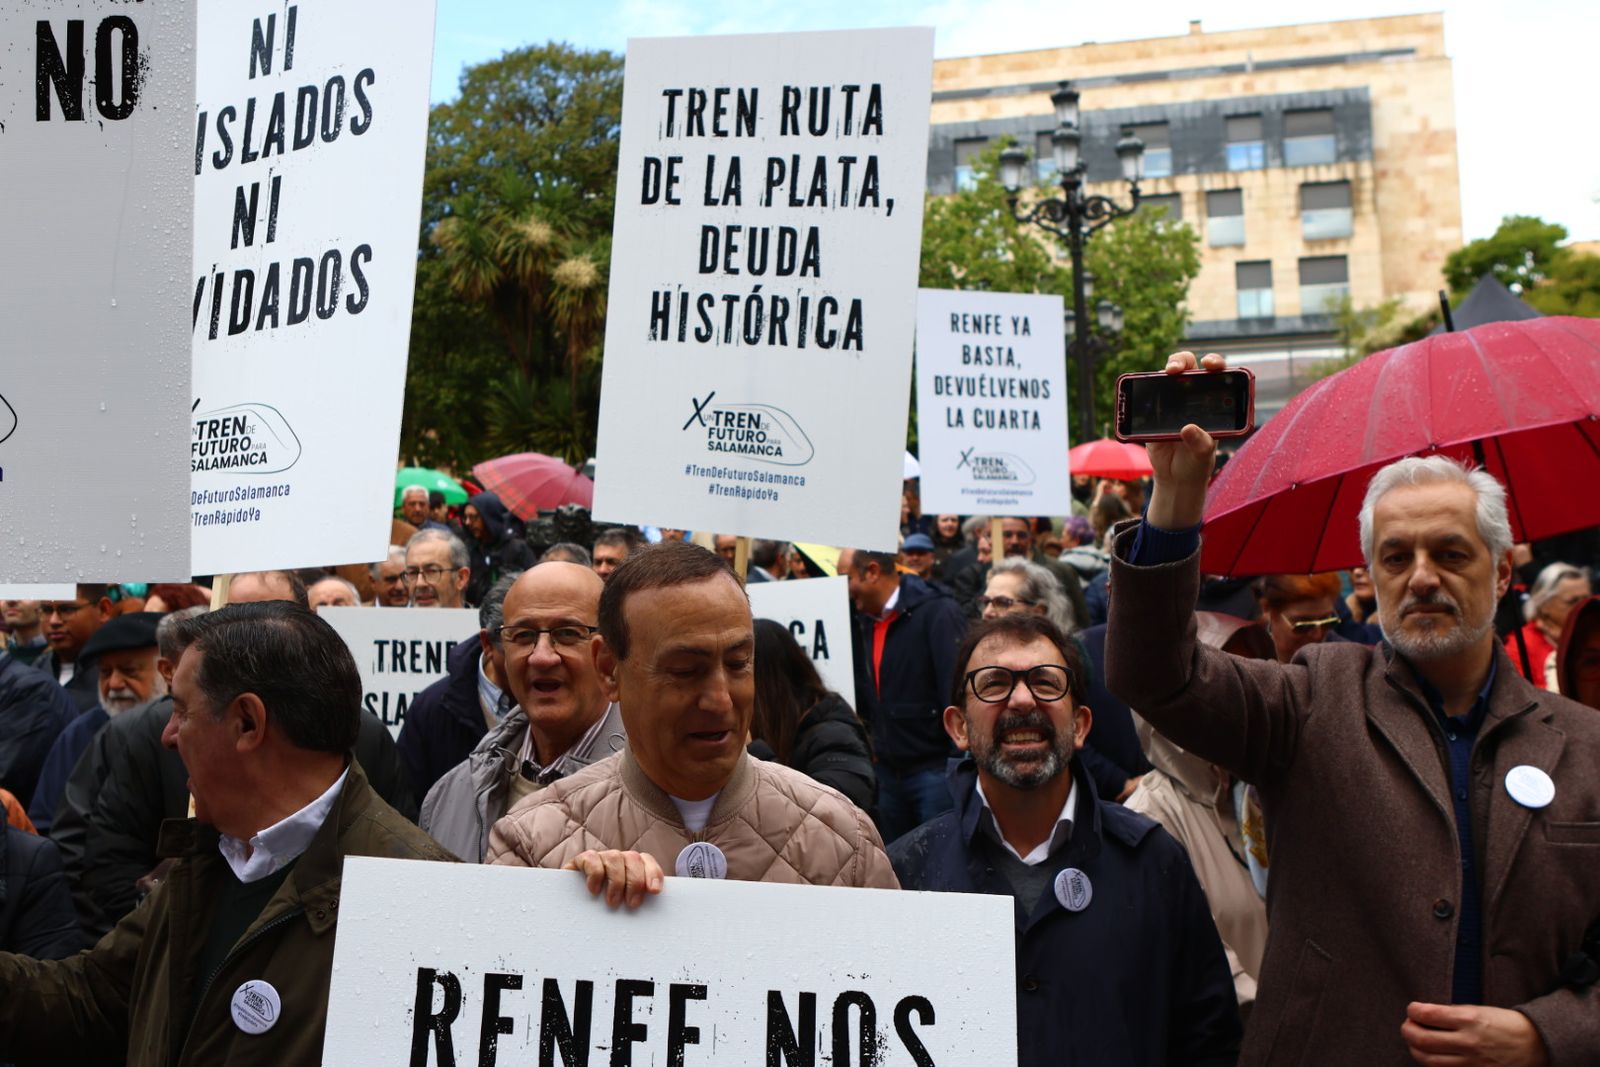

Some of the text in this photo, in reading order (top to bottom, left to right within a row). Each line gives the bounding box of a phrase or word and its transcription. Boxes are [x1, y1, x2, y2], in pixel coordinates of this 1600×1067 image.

[248, 4, 298, 80] NI
[36, 15, 140, 122] NO
[661, 83, 884, 139] TREN RUTA
[640, 154, 894, 217] DE LA PLATA,
[230, 175, 282, 250] NI
[698, 224, 821, 278] DEUDA
[649, 284, 864, 352] HISTÓRICA
[950, 312, 1031, 336] RENFE YA
[961, 344, 1022, 370] BASTA,
[934, 374, 1051, 399] DEVUÉLVENOS
[196, 415, 247, 441] TREN
[712, 410, 761, 430] TREN
[946, 406, 1041, 431] LA CUARTA
[191, 436, 252, 458] FUTURO
[707, 426, 767, 444] FUTURO
[707, 440, 783, 457] SALAMANCA
[684, 463, 806, 487] #TrenDeFuturoSalamanca
[708, 483, 779, 501] #TrenRápidoYa
[191, 507, 261, 527] TrenRápidoYa
[766, 989, 936, 1067] NOS
